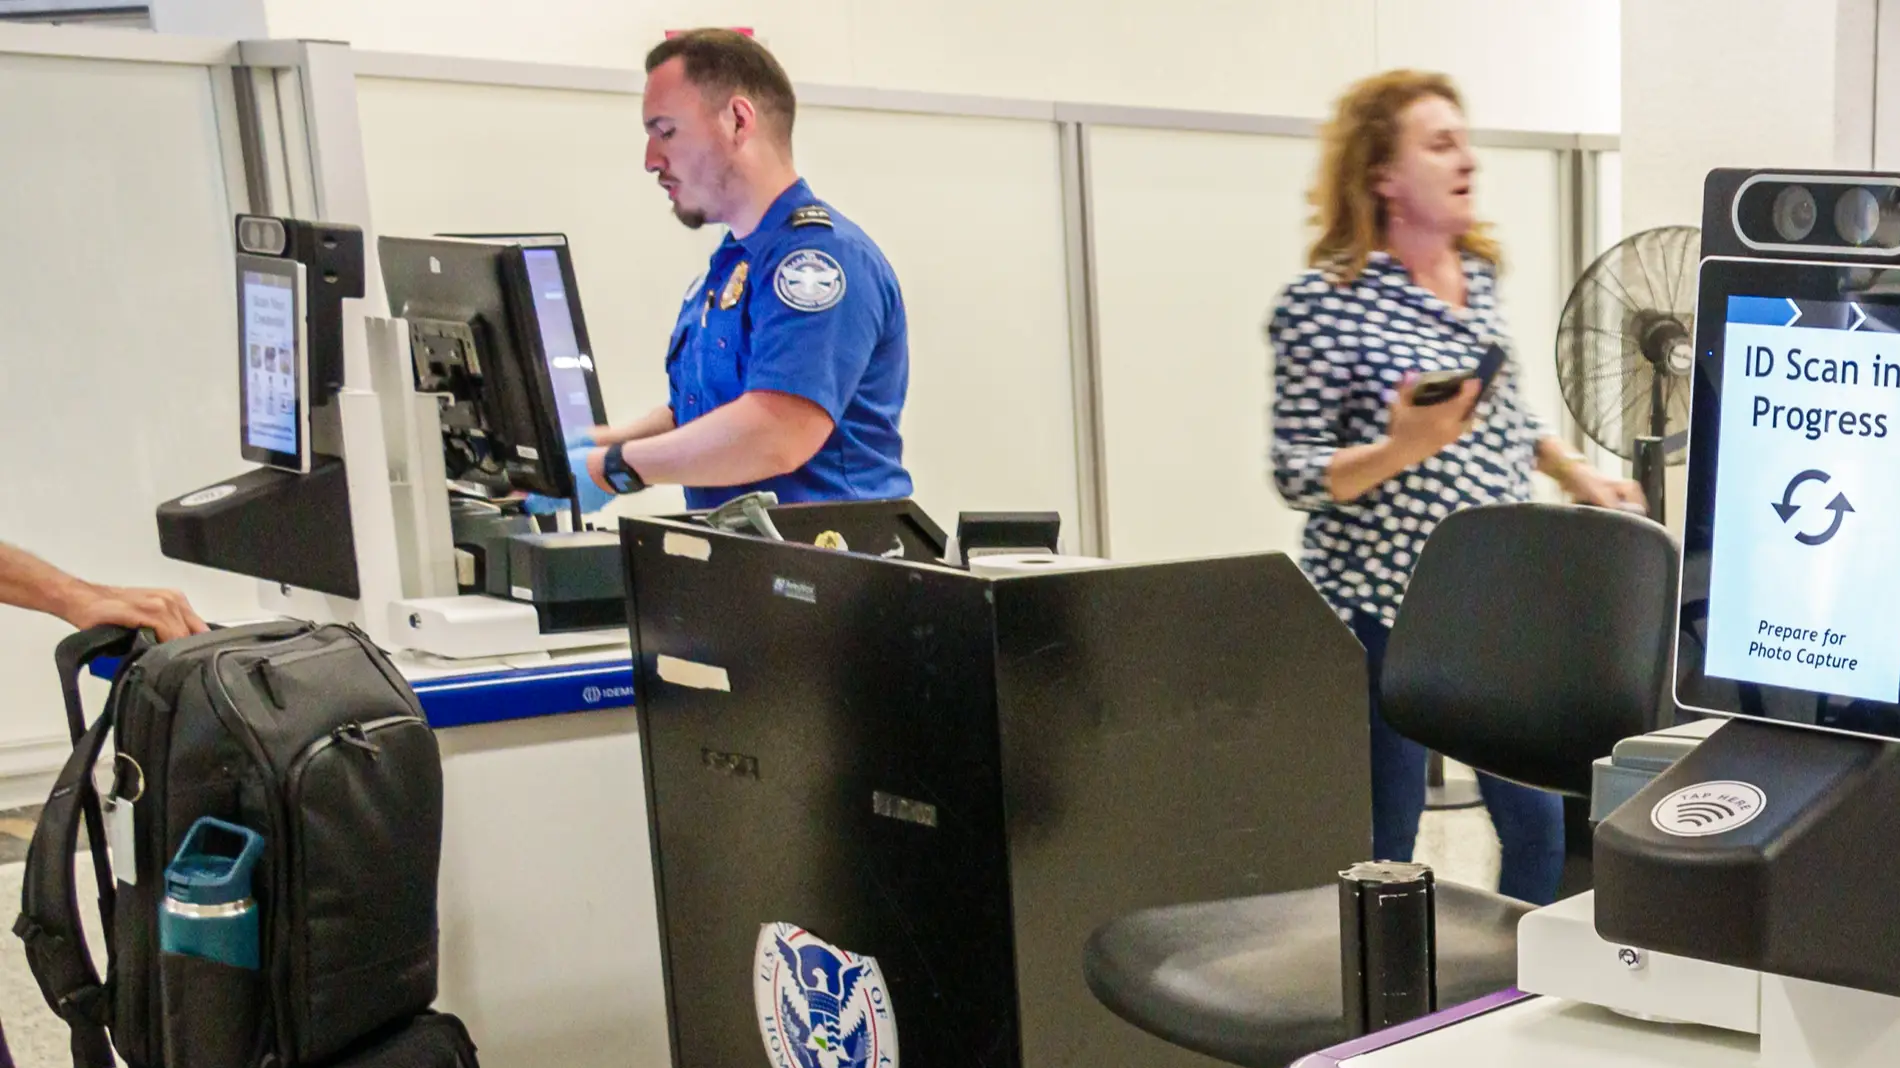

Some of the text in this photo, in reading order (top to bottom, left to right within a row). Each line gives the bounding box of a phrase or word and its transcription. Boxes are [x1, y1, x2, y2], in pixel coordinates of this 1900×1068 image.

[1745, 345, 1900, 388] ID Scan in
[1753, 396, 1887, 440] Progress
[1758, 620, 1846, 647] Prepare for
[1749, 641, 1857, 670] Photo Capture
[1681, 792, 1751, 811] TAP HERE
